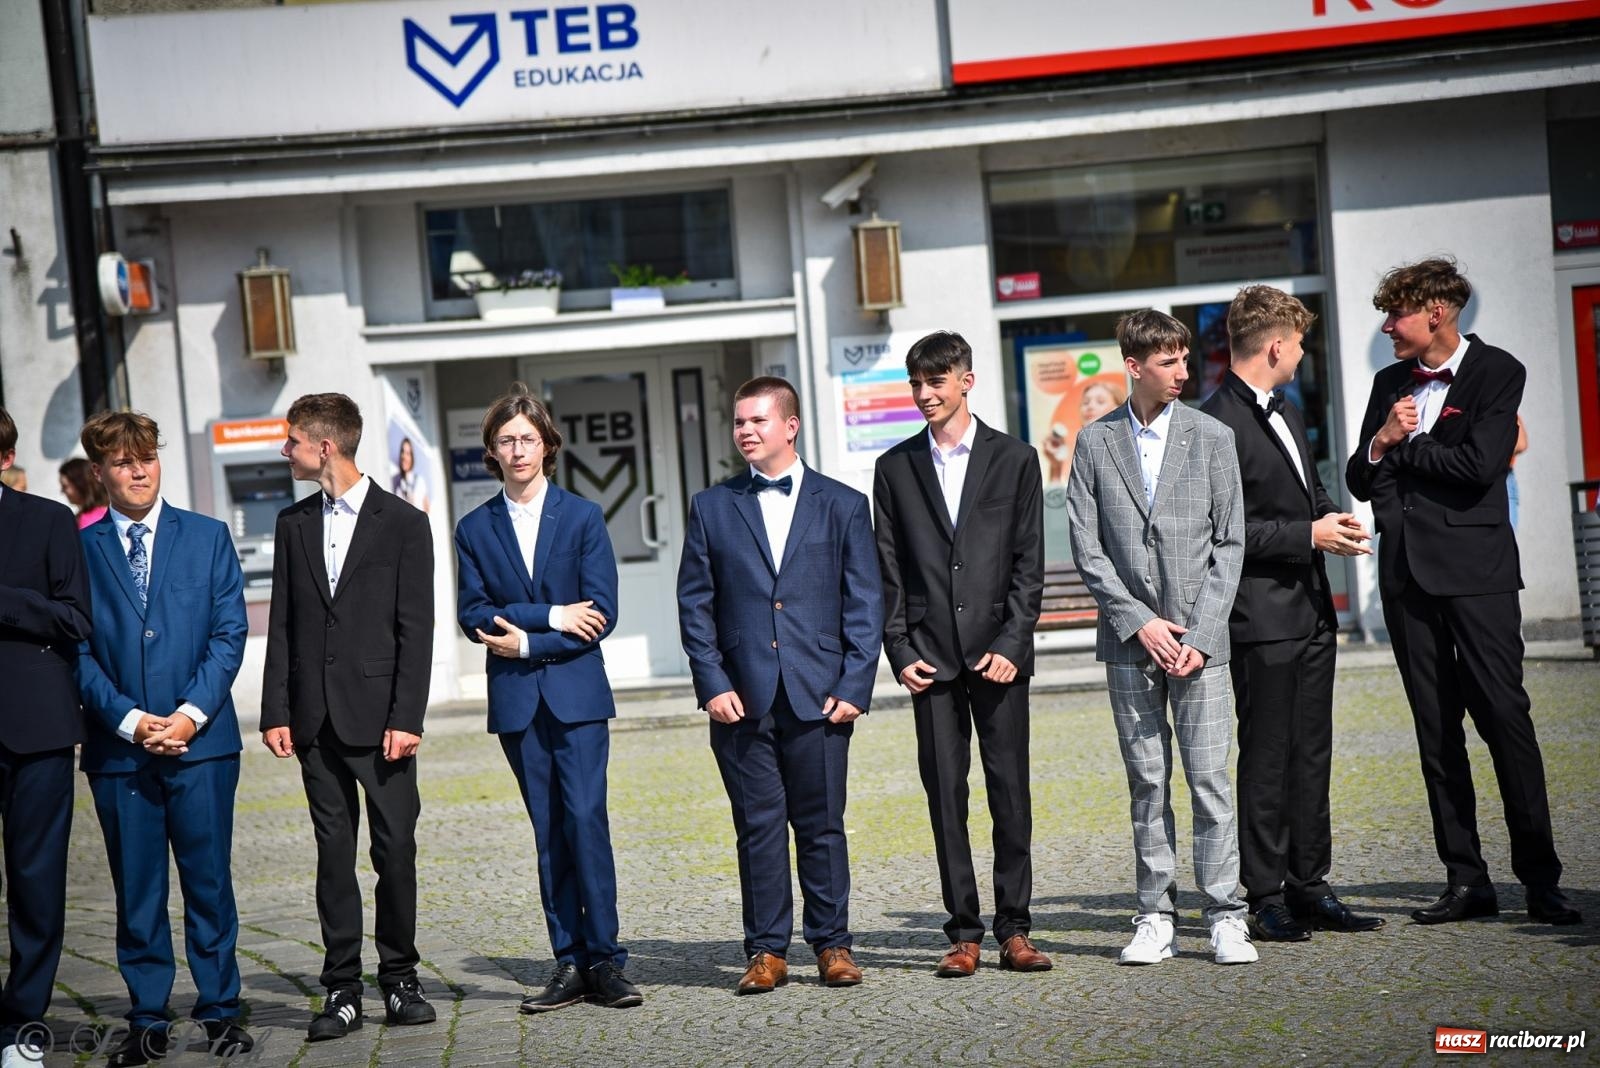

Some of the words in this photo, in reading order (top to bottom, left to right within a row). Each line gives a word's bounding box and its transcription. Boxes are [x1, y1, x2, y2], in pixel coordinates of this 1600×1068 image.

[510, 4, 639, 57] TEB
[513, 62, 643, 88] EDUKACJA
[560, 411, 635, 444] TEB
